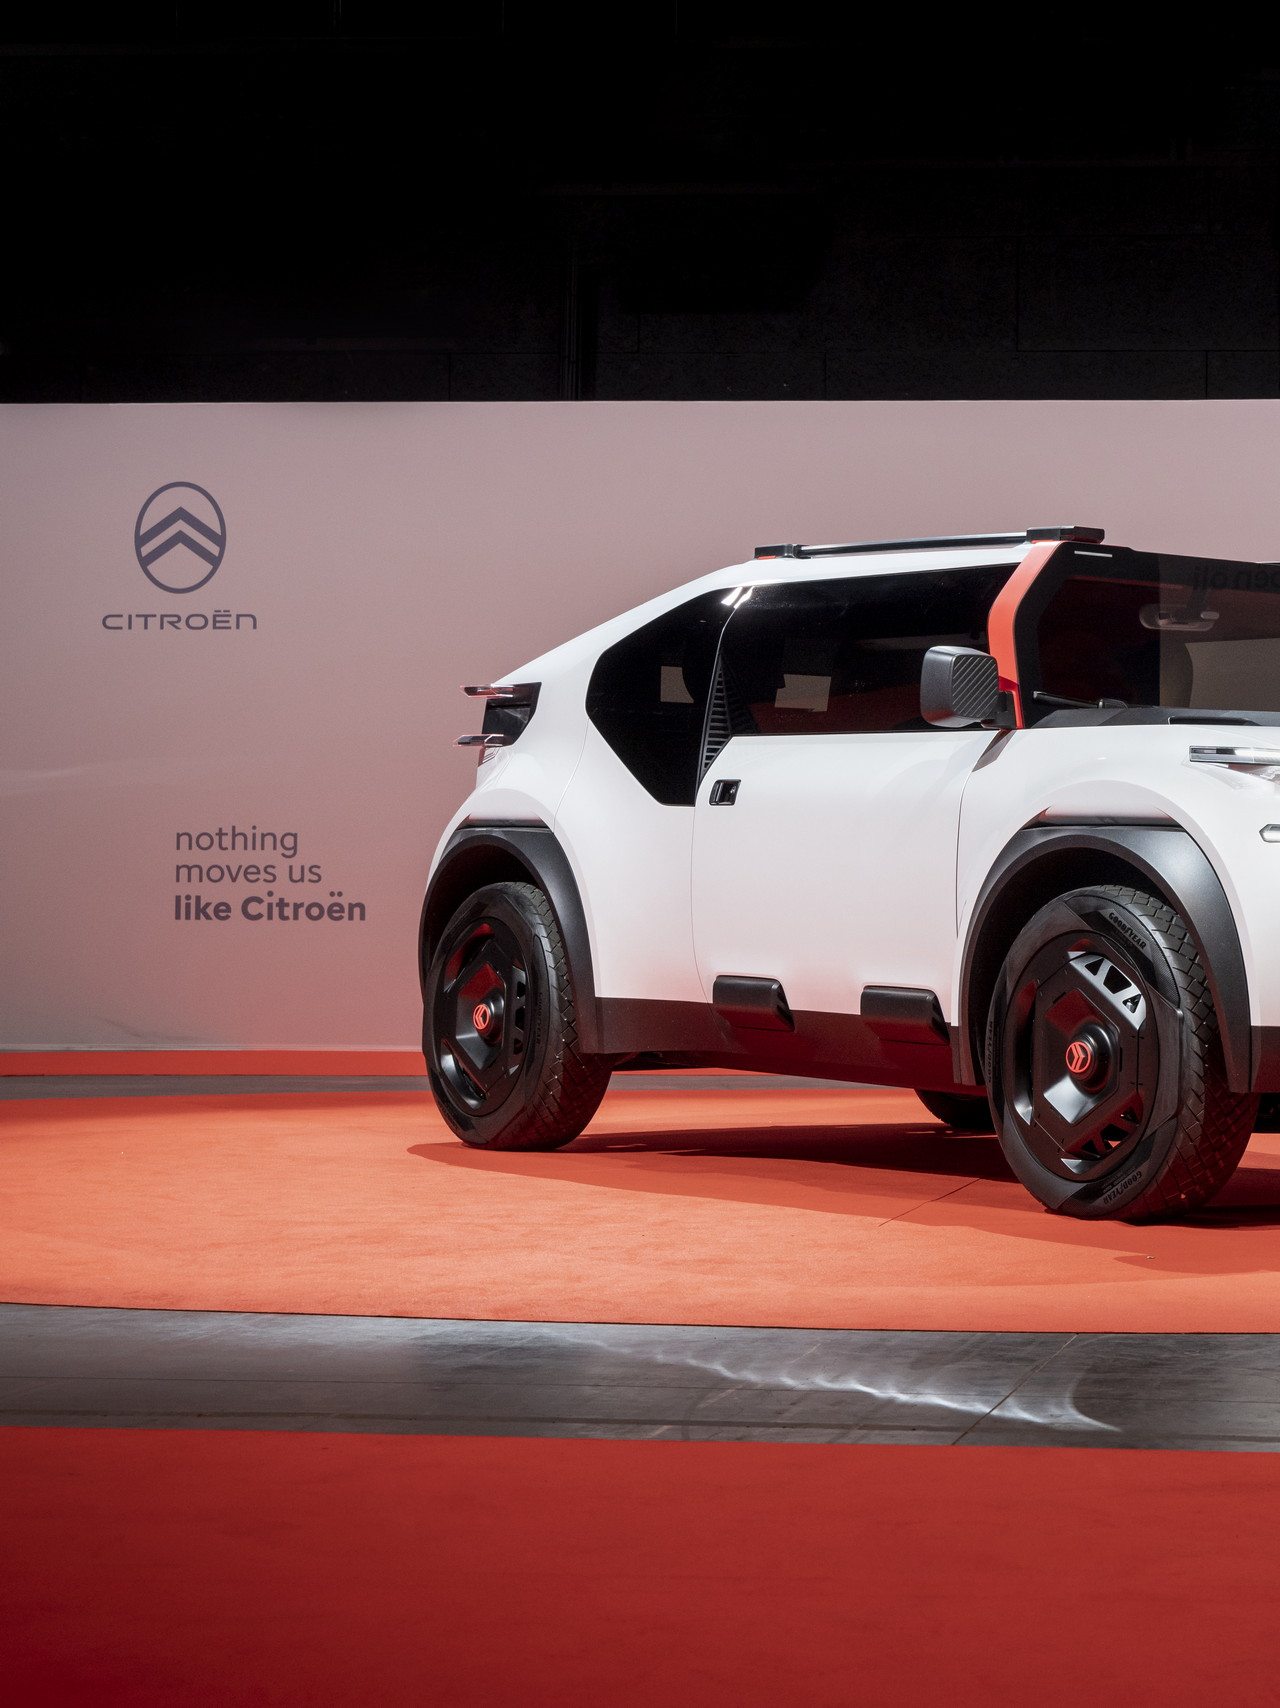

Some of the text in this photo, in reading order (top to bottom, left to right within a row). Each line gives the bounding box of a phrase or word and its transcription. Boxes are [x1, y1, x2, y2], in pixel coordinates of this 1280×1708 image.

[175, 824, 299, 860] nothing
[175, 863, 322, 884] moves us
[173, 890, 367, 922] like Citroën
[1108, 912, 1147, 950] GOODYEAR
